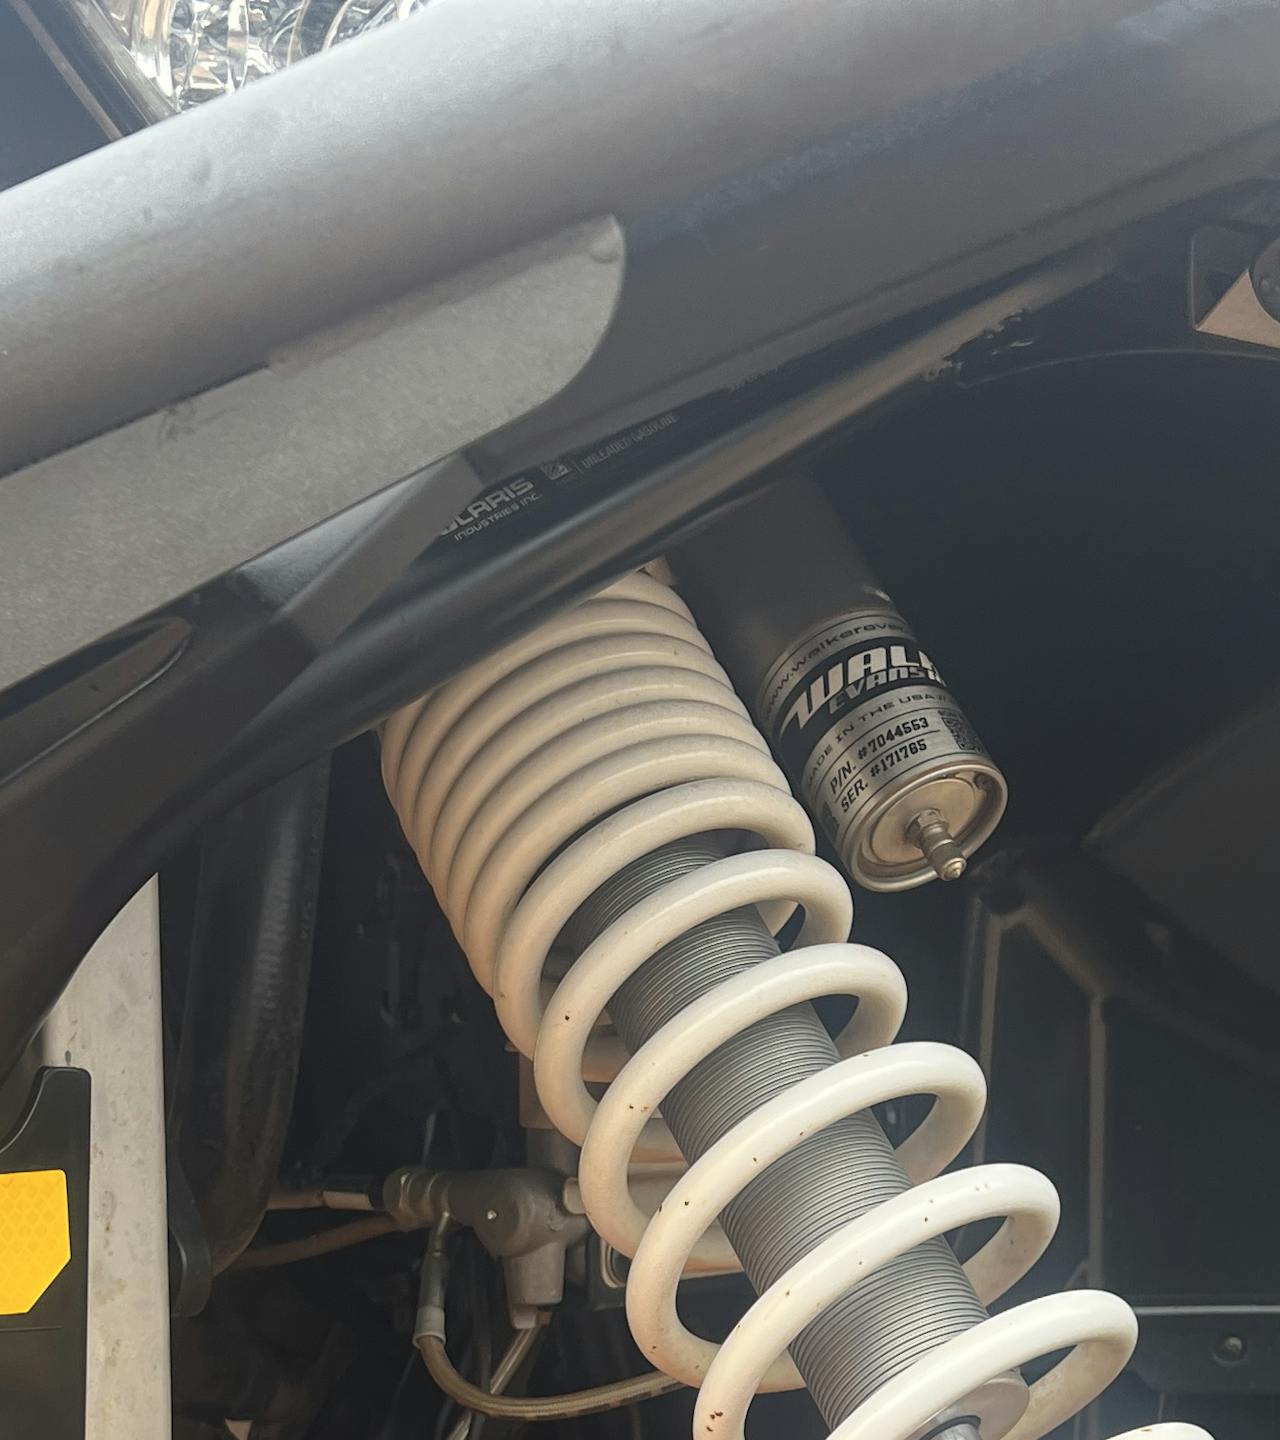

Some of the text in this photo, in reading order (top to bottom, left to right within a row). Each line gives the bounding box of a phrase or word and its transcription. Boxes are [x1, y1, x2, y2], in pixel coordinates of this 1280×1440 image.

[439, 476, 535, 536] LARIS
[834, 723, 855, 745] IN
[859, 701, 896, 722] THE
[898, 693, 936, 705] USA
[829, 760, 857, 795] P/N.
[840, 778, 869, 813] SER.
